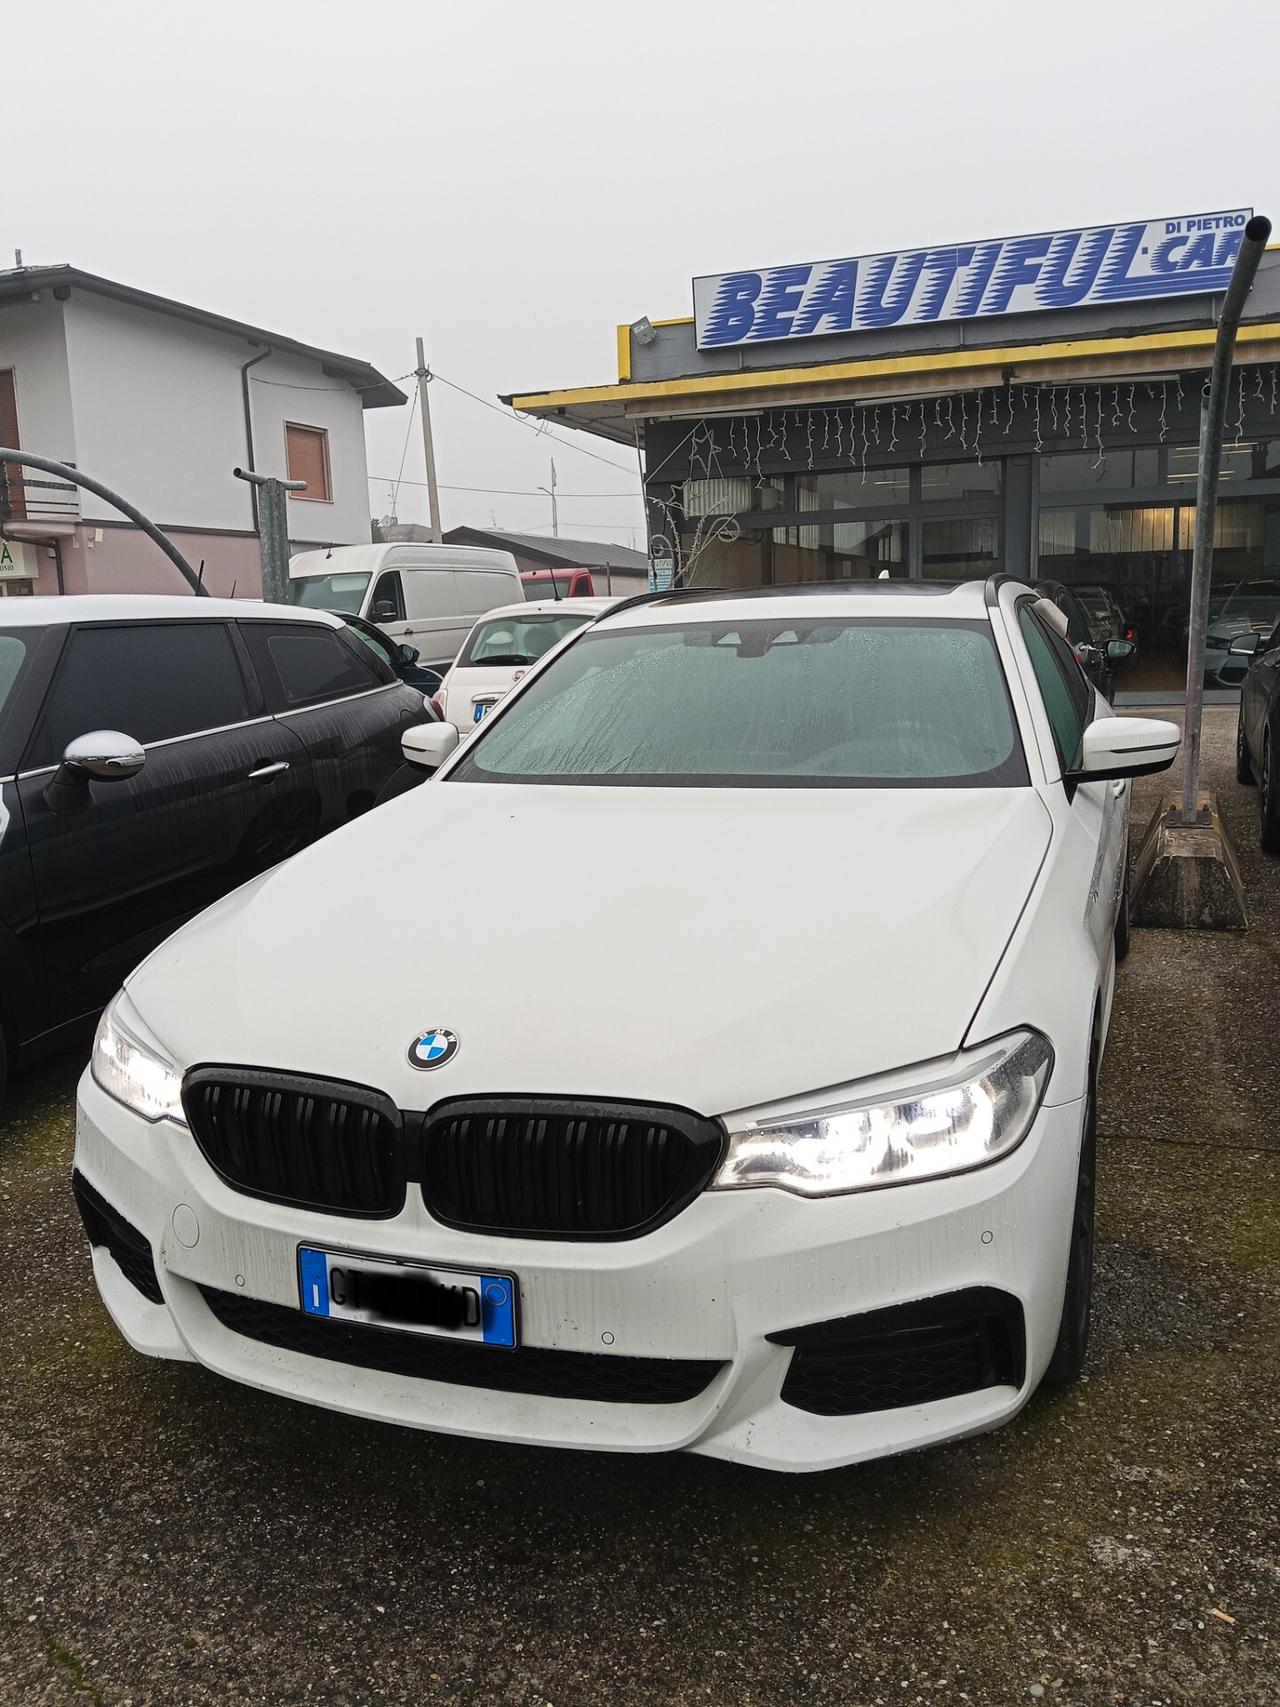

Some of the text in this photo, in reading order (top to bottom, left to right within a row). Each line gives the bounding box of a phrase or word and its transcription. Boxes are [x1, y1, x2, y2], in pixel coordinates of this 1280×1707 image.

[1165, 214, 1246, 235] DI PIETRO
[700, 224, 1149, 346] BEAUTIFUL
